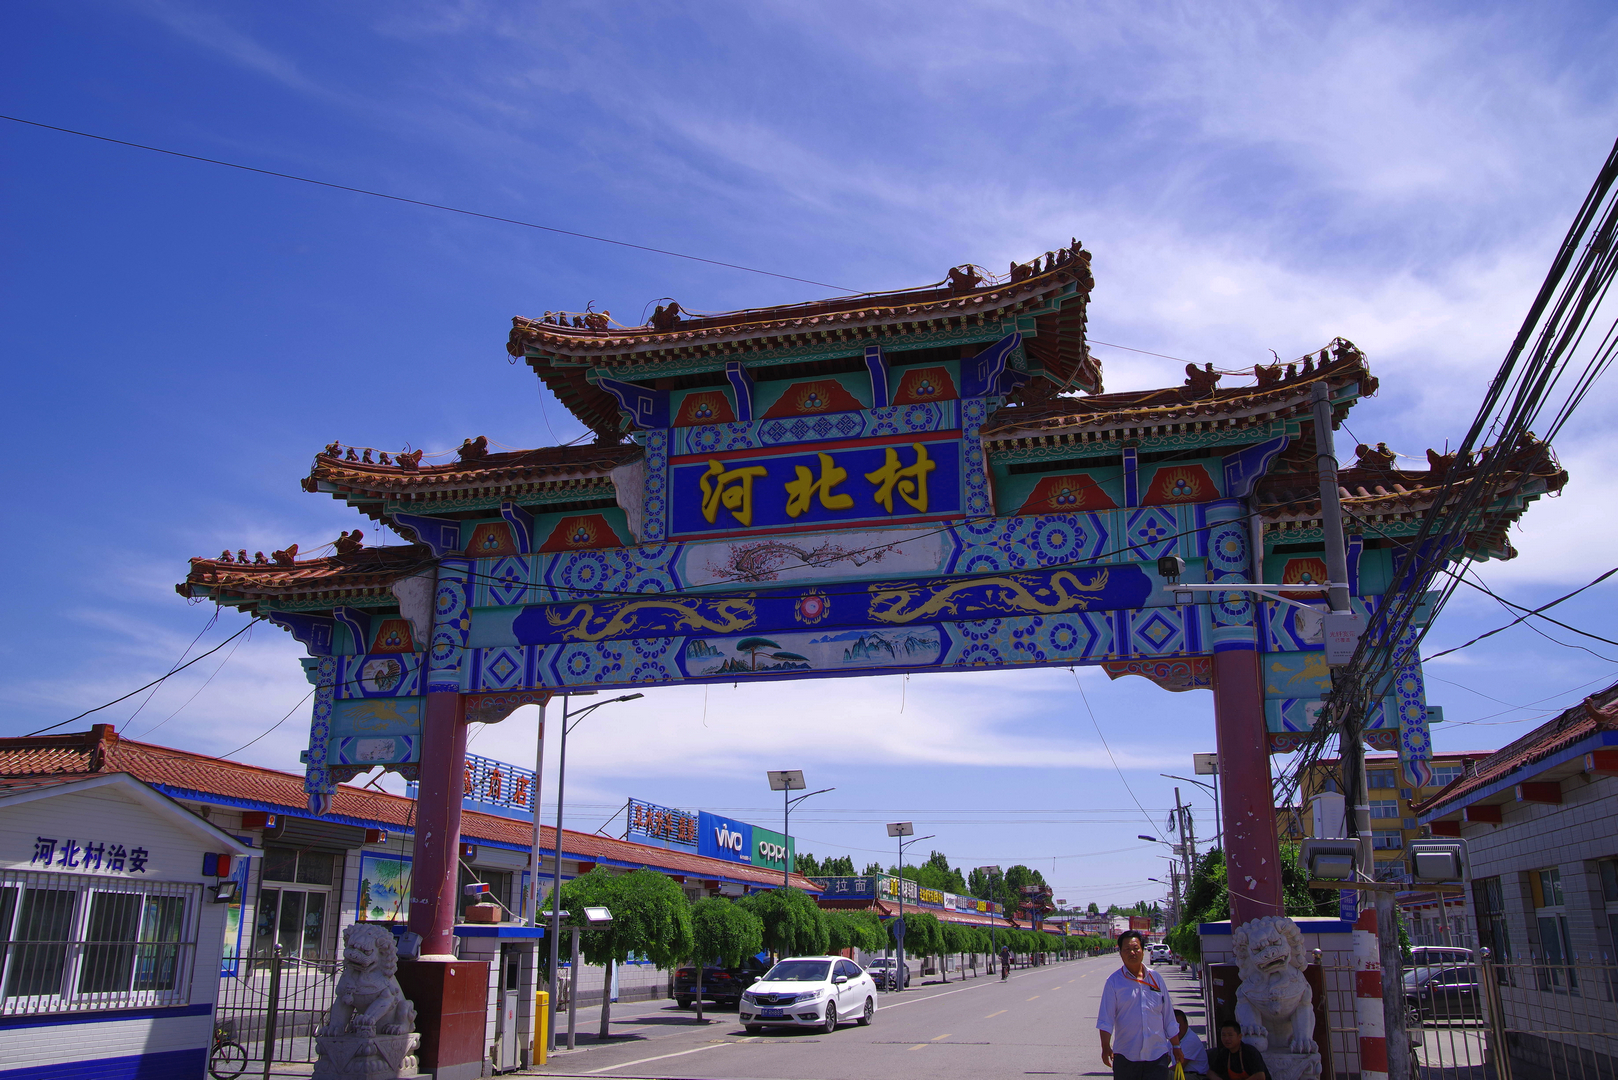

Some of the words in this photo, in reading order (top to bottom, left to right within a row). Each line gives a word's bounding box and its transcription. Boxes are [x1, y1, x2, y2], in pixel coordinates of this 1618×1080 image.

[699, 442, 937, 528] 河北村
[30, 836, 149, 874] 河北村治安
[714, 823, 743, 851] vivo
